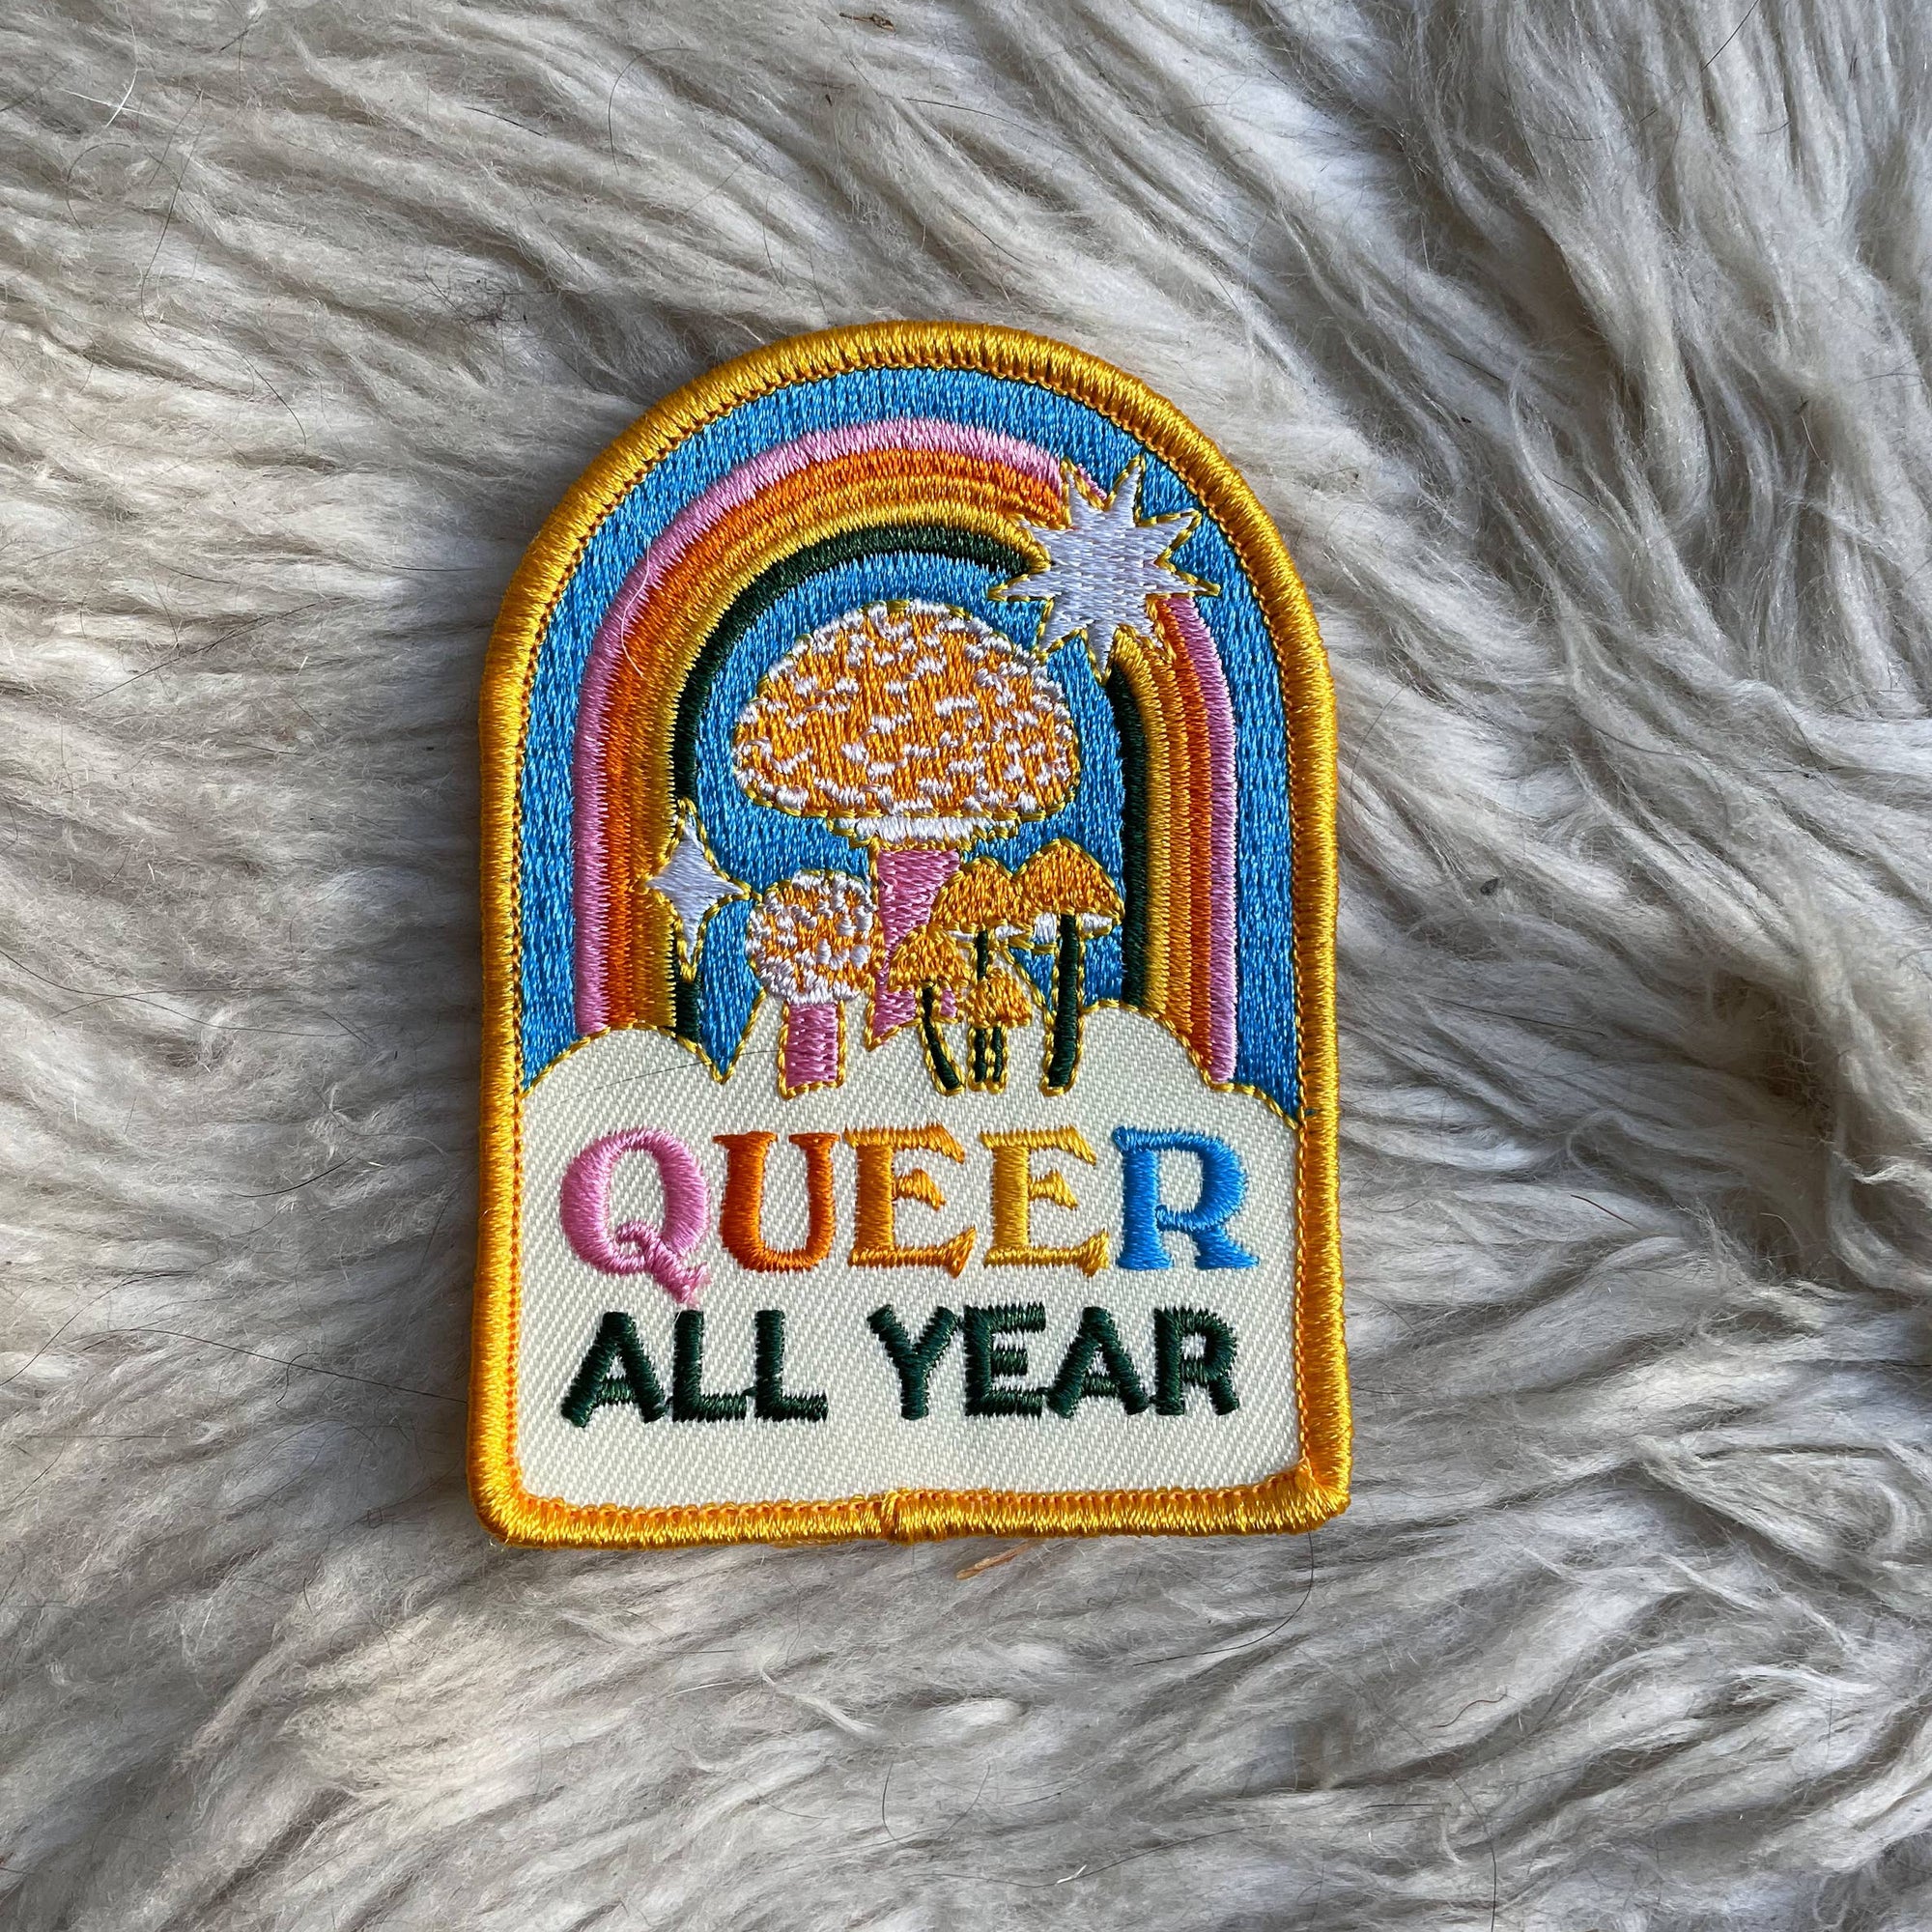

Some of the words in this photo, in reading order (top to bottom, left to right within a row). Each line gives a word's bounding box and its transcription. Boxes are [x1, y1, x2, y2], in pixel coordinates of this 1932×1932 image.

[561, 1122, 1259, 1304] QUEER
[562, 1310, 827, 1430] ALL
[868, 1302, 1237, 1420] YEAR
